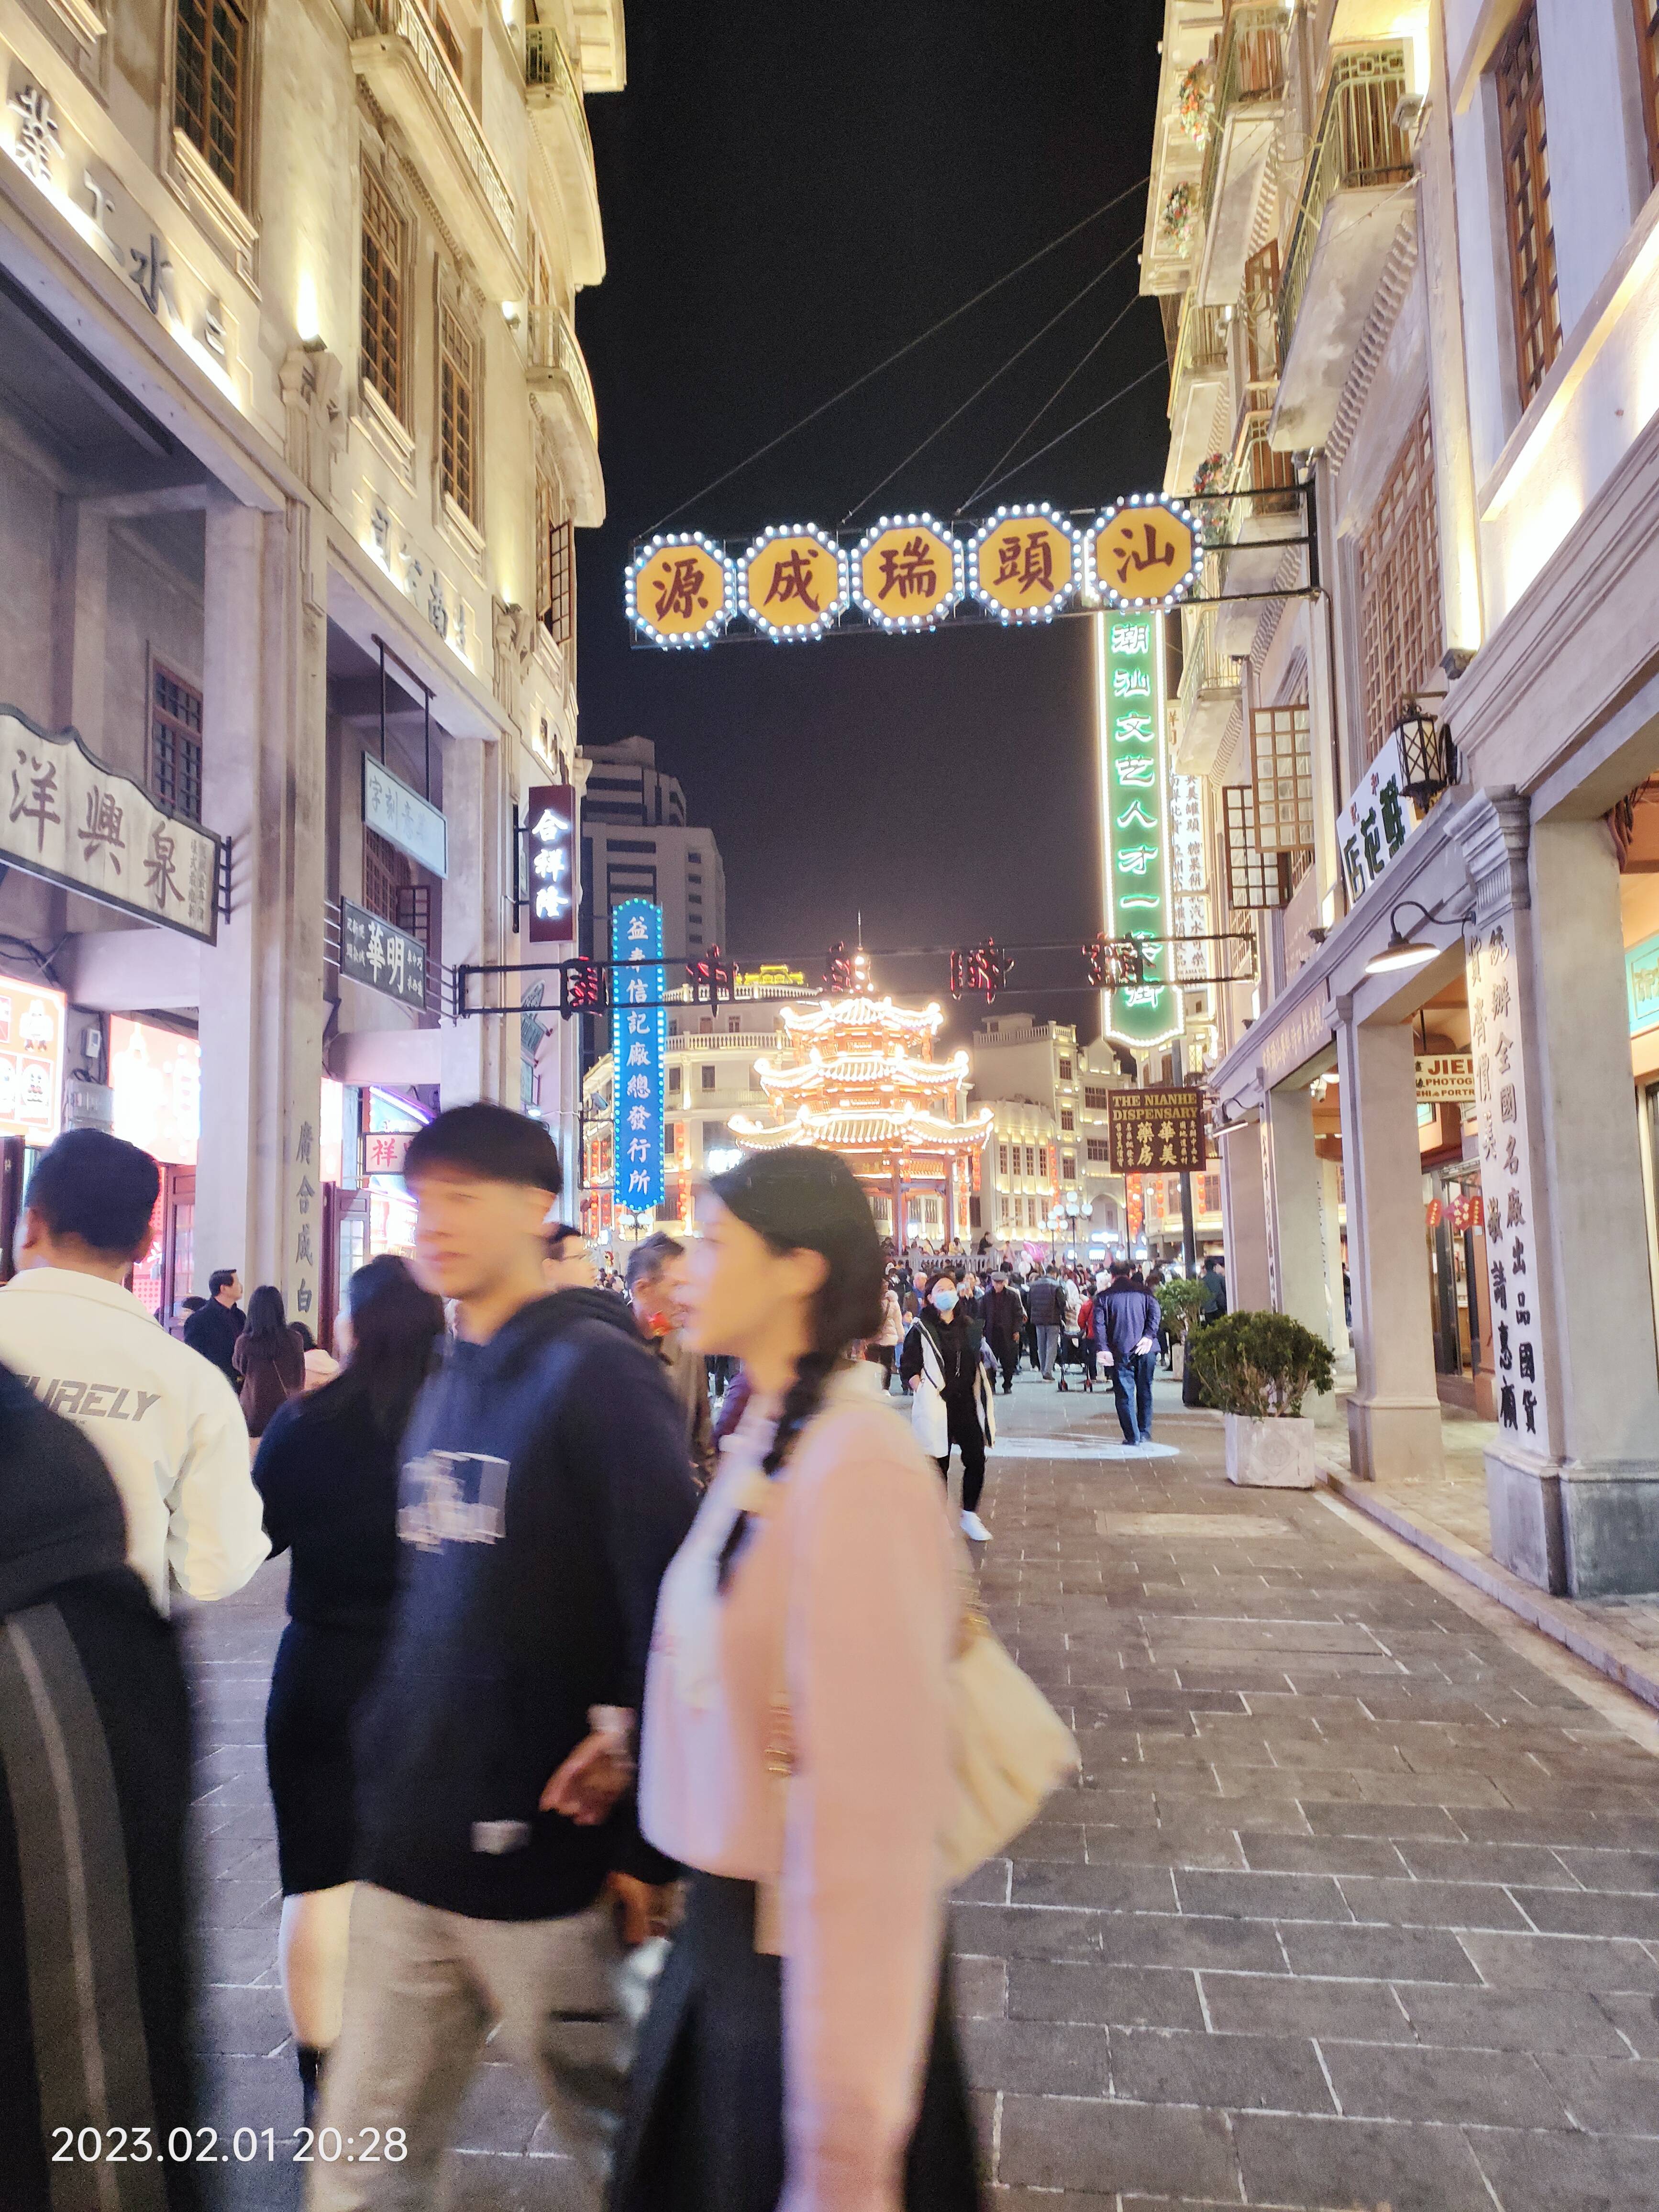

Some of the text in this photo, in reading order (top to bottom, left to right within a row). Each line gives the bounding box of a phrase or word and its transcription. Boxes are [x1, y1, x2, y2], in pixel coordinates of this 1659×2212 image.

[531, 808, 568, 918] 合祥隆
[1426, 1077, 1474, 1086] PHOTOG
[1112, 1093, 1197, 1107] THE NIANHE
[1112, 1107, 1198, 1121] DISPENSARY
[16, 1374, 161, 1422] URELY
